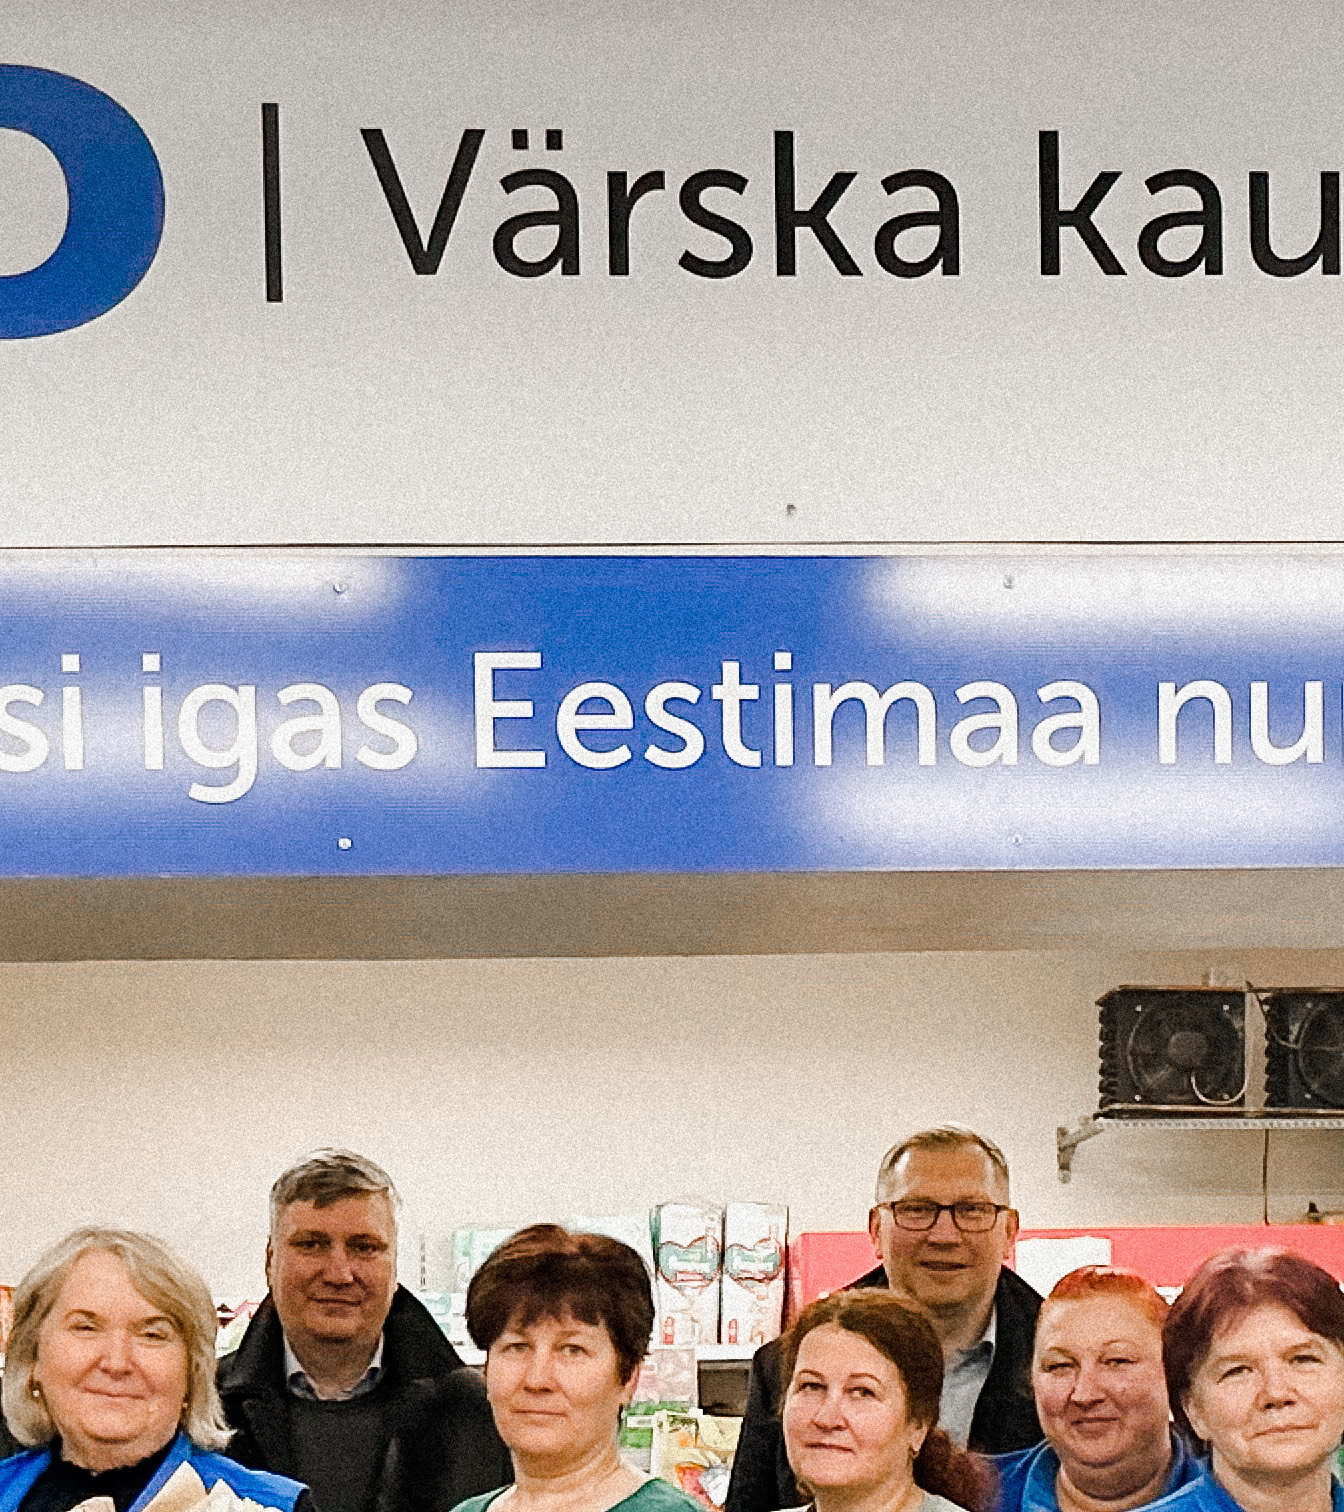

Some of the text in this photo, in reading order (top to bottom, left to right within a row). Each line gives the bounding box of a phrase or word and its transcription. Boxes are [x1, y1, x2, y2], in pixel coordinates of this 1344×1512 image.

[360, 127, 960, 280] Värska
[141, 653, 417, 804] igas
[474, 649, 1102, 771] Eestimaa
